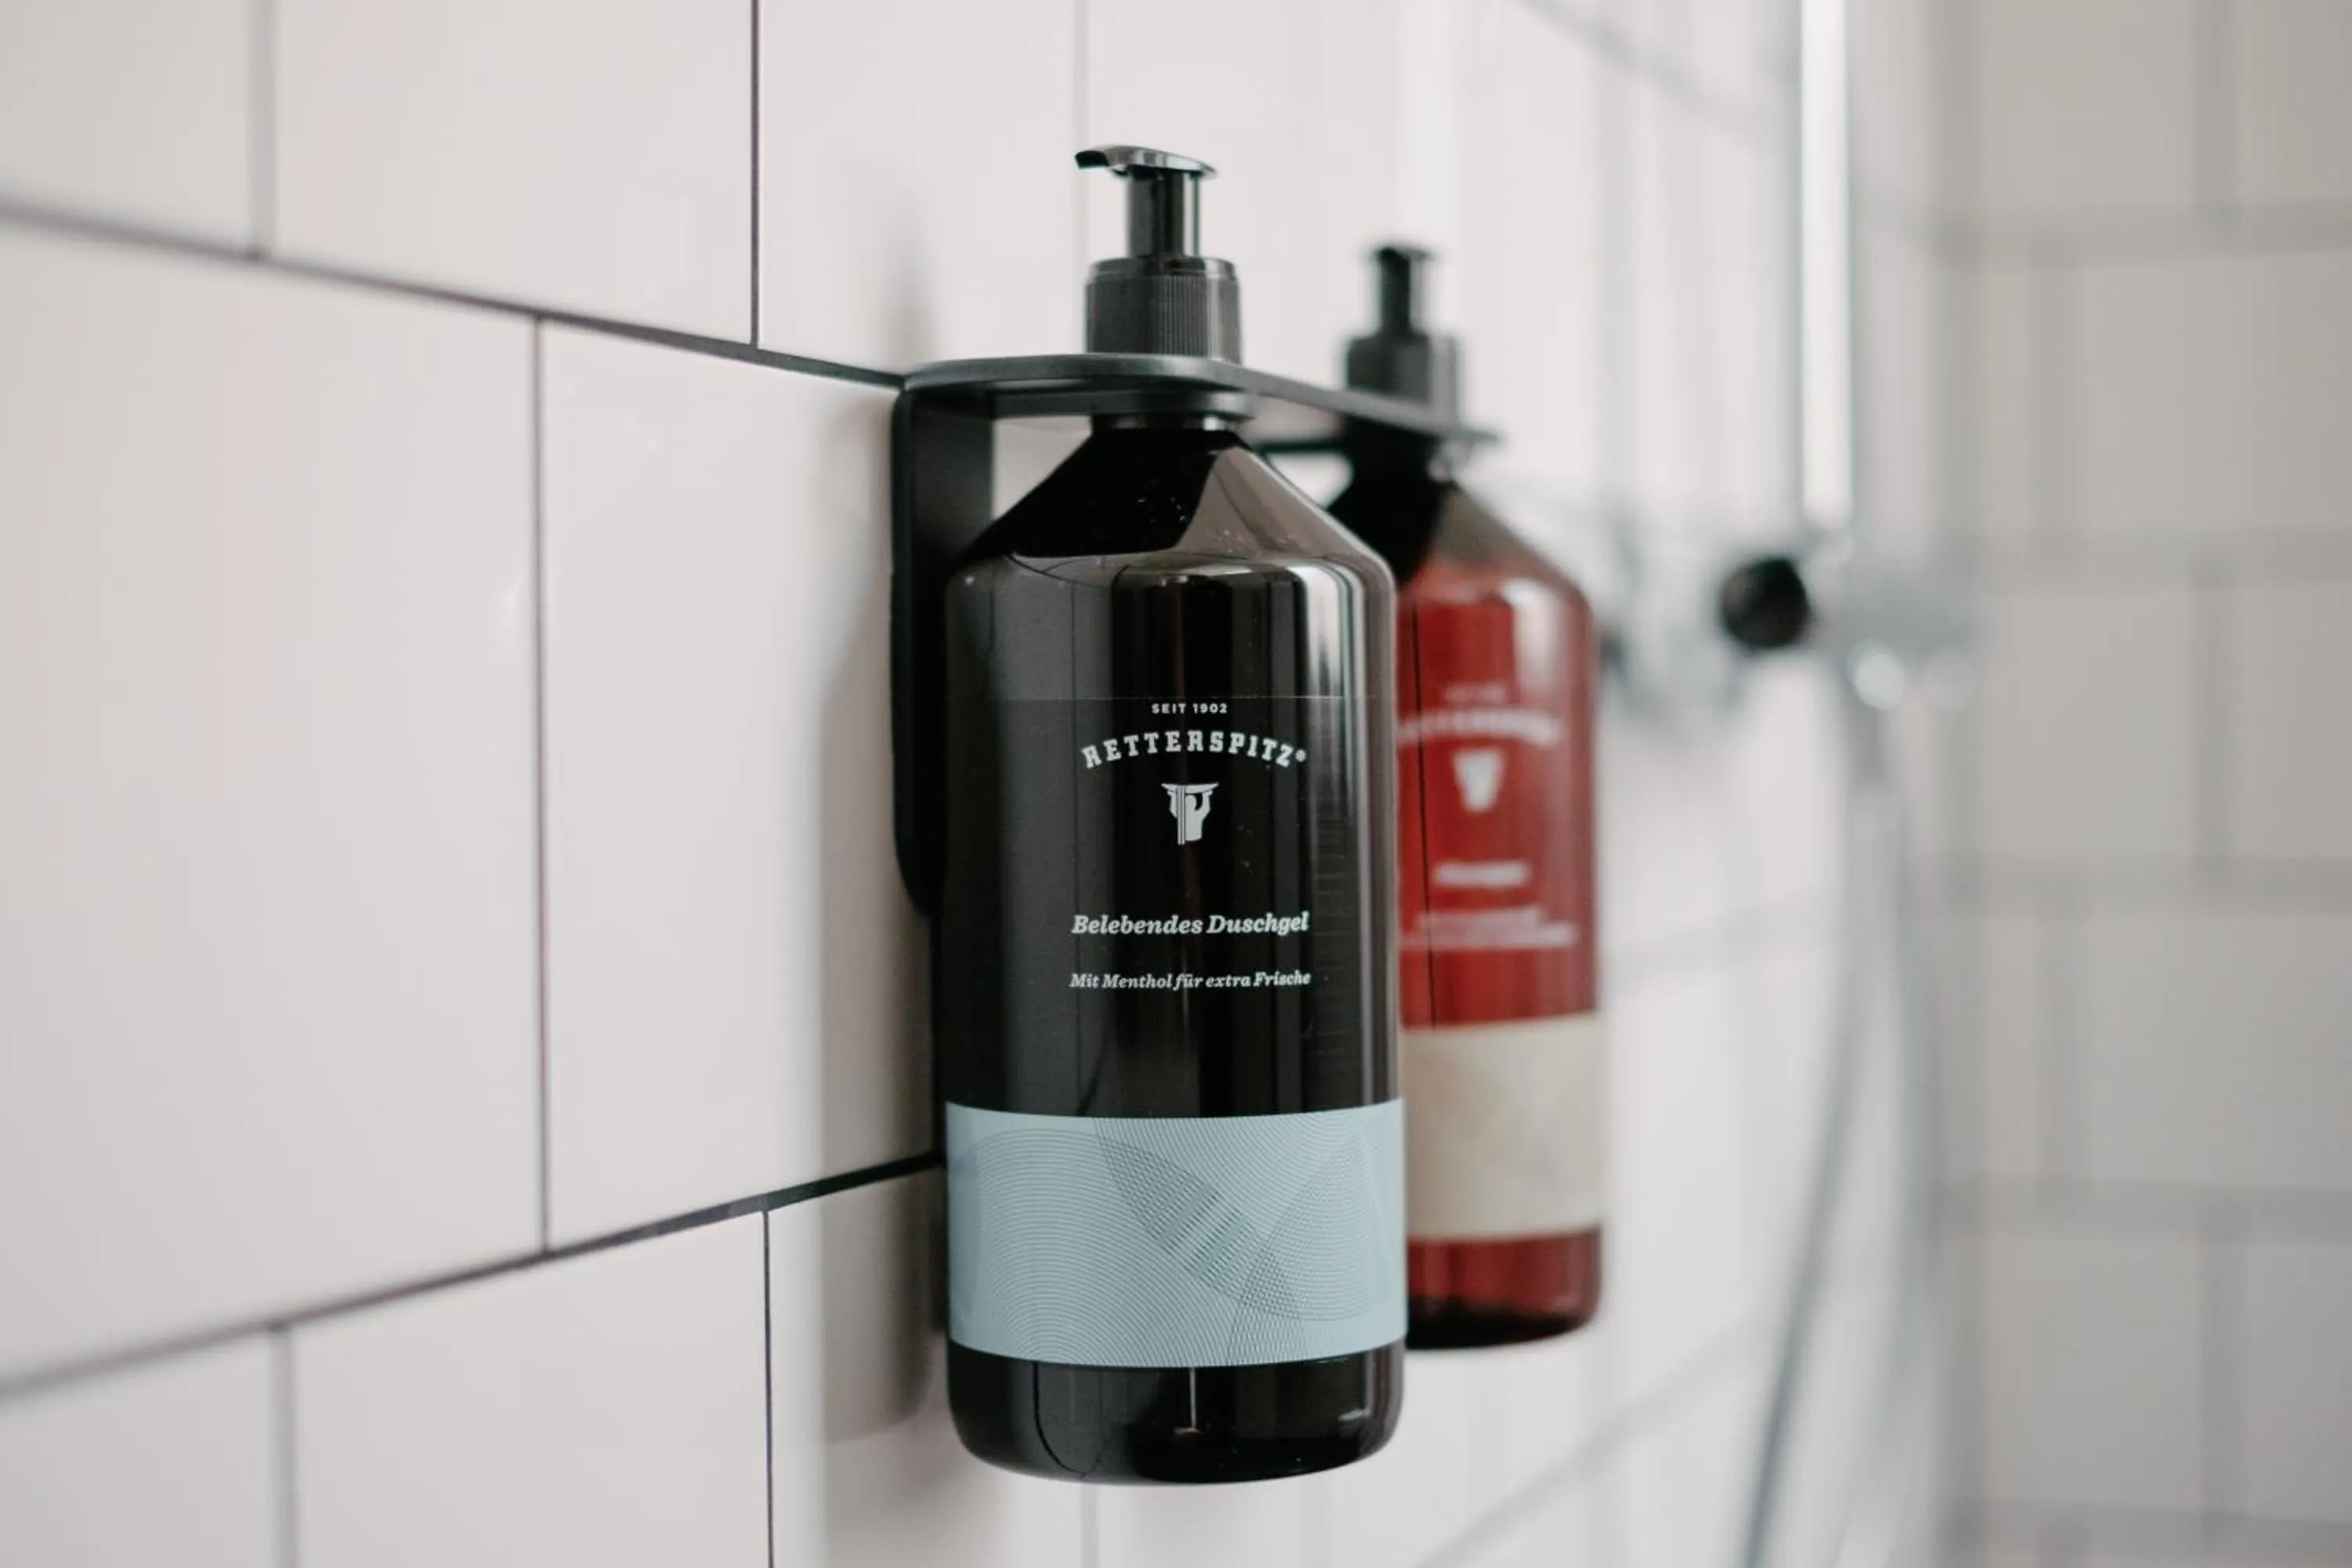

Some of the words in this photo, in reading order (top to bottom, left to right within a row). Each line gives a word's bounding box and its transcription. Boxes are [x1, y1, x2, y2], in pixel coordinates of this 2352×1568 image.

[1152, 703, 1187, 714] SEIT
[1192, 703, 1228, 714] 1902
[1071, 914, 1203, 935] Belebendes
[1207, 911, 1310, 937] Duschgel
[1069, 973, 1100, 988] Mit
[1102, 972, 1173, 989] Menthol
[1172, 971, 1203, 992] für
[1206, 973, 1251, 988] extra
[1253, 970, 1312, 987] Frische
